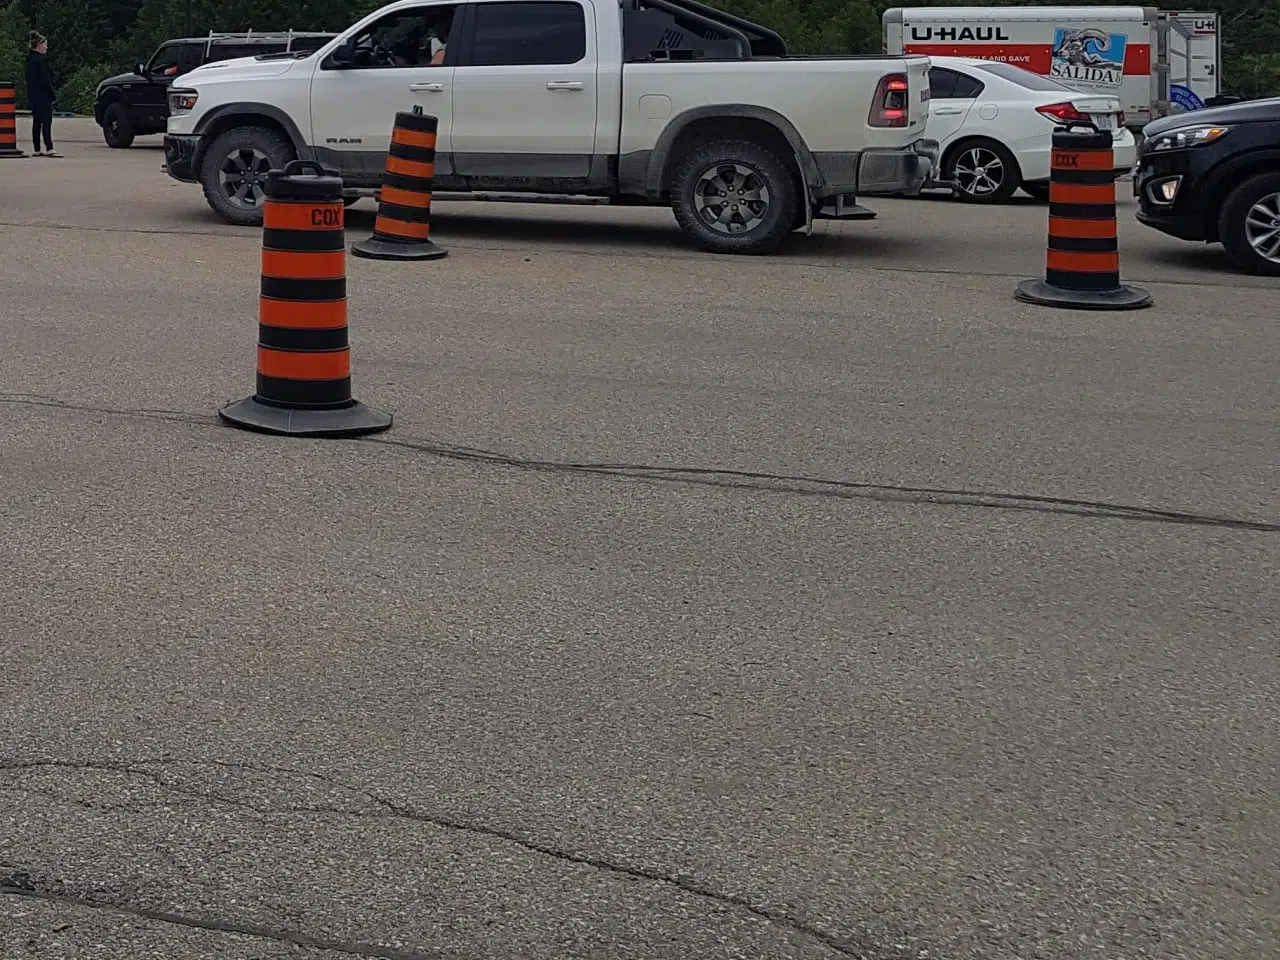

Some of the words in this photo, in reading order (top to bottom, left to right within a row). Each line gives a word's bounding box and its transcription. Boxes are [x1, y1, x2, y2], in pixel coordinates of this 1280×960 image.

[911, 27, 1009, 41] U-HAUL
[1051, 64, 1114, 83] SALIDA
[311, 207, 340, 227] COX
